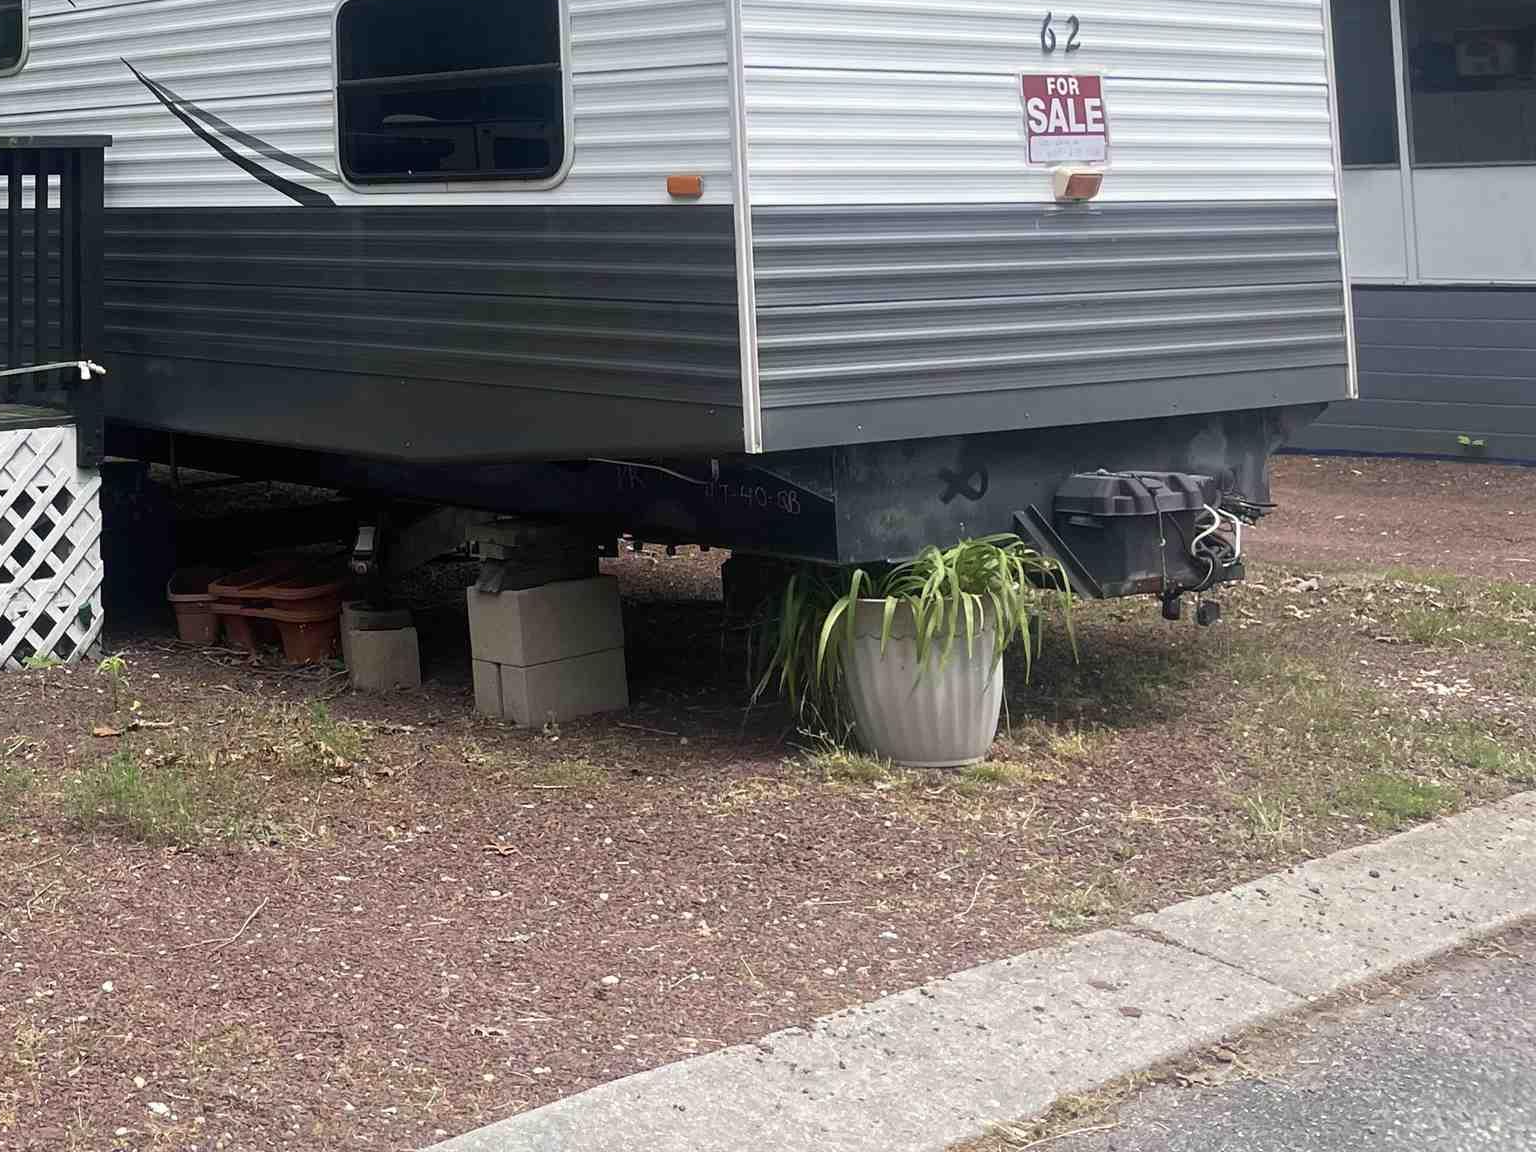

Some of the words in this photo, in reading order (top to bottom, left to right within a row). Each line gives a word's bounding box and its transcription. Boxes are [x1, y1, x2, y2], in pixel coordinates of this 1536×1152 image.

[1040, 11, 1081, 54] 62
[1046, 76, 1080, 95] FOR
[1027, 97, 1105, 134] SALE
